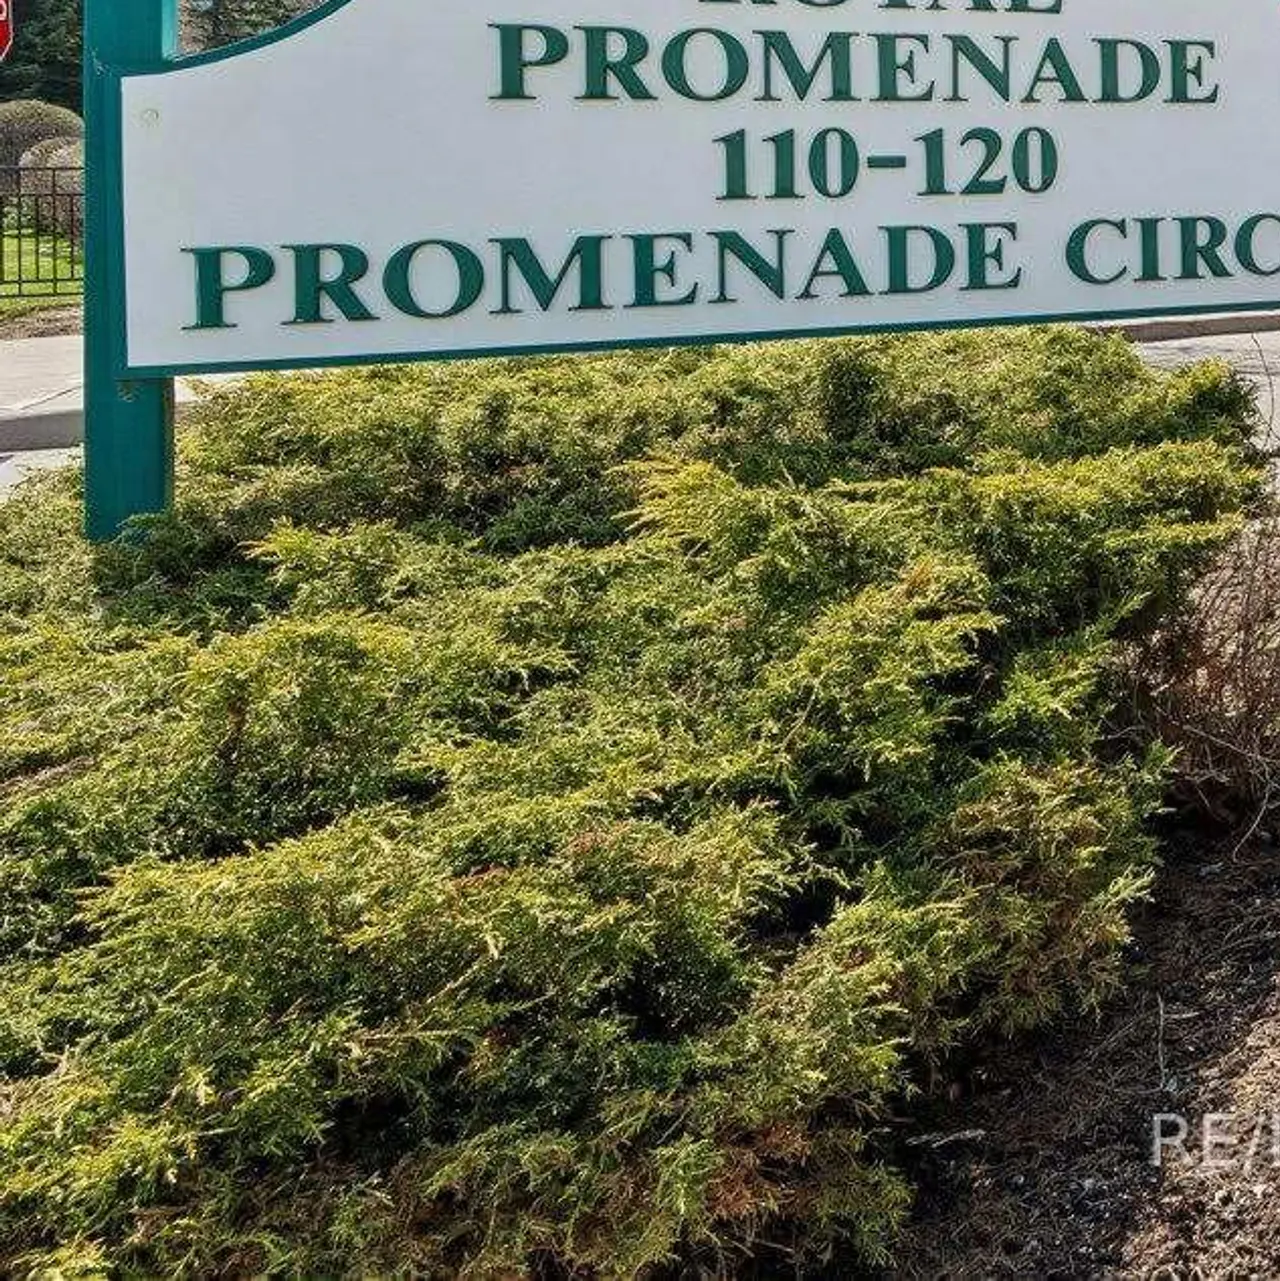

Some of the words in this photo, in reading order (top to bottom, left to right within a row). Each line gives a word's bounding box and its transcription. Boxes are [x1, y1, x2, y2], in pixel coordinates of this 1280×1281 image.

[488, 22, 1219, 104] PROMENADE
[713, 126, 1059, 201] 110-120
[179, 221, 1024, 330] PROMENADE
